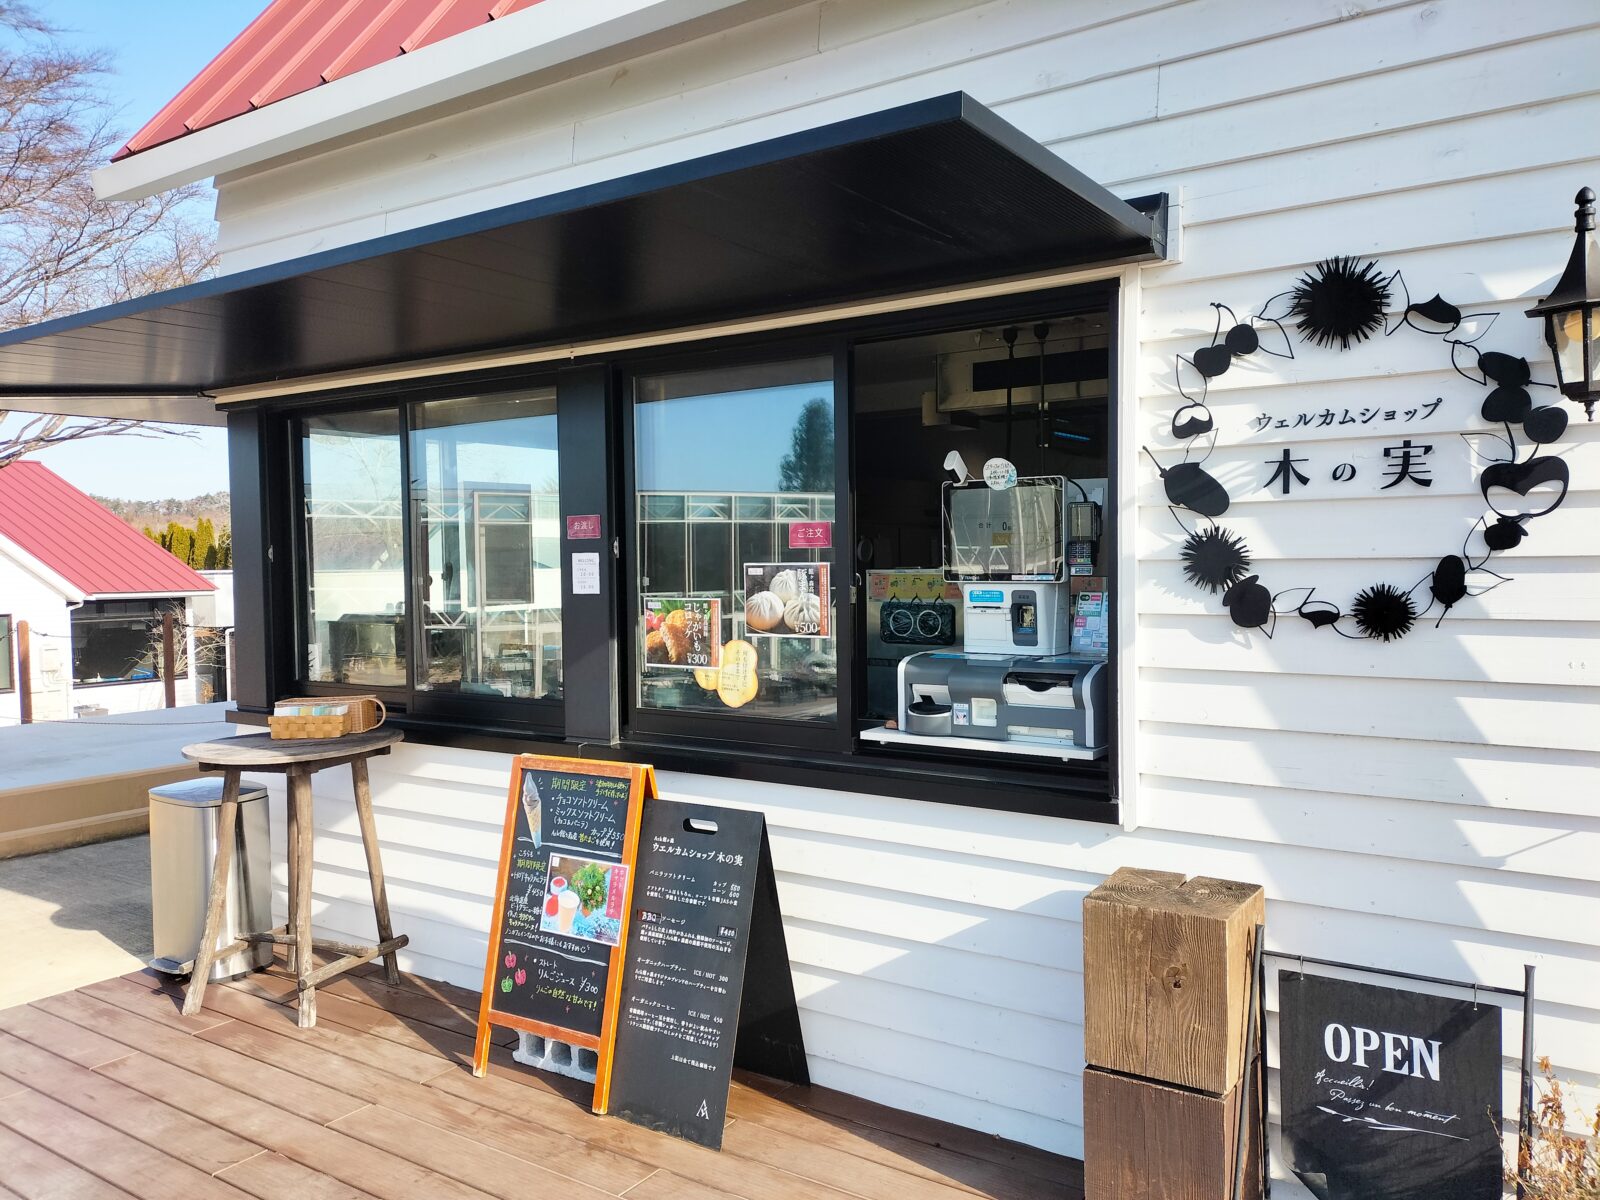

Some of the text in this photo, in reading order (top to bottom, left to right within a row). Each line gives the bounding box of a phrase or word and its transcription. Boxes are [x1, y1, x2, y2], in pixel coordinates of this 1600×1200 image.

[1256, 397, 1443, 433] ウェルカムショップ
[1263, 440, 1433, 495] 木の実
[574, 521, 594, 530] お渡し
[797, 527, 824, 539] ご注文
[684, 603, 693, 638] コロッケ
[692, 602, 702, 651] じゃがいも
[794, 622, 818, 634] ¥500
[687, 653, 708, 665] ¥300
[551, 776, 587, 792] 期間限定
[556, 792, 609, 812] チョコソフトクリーム
[555, 806, 616, 824] ミックスソフトクリーム
[516, 859, 547, 873] 期間限定
[716, 852, 744, 867] 木の実
[538, 958, 558, 969] ストレート
[538, 968, 598, 995] りんごジュース ¥300
[1324, 1022, 1443, 1082] OPEN
[1329, 1088, 1365, 1111] Passez
[1385, 1102, 1402, 1113] bon
[1406, 1109, 1461, 1124] moment
